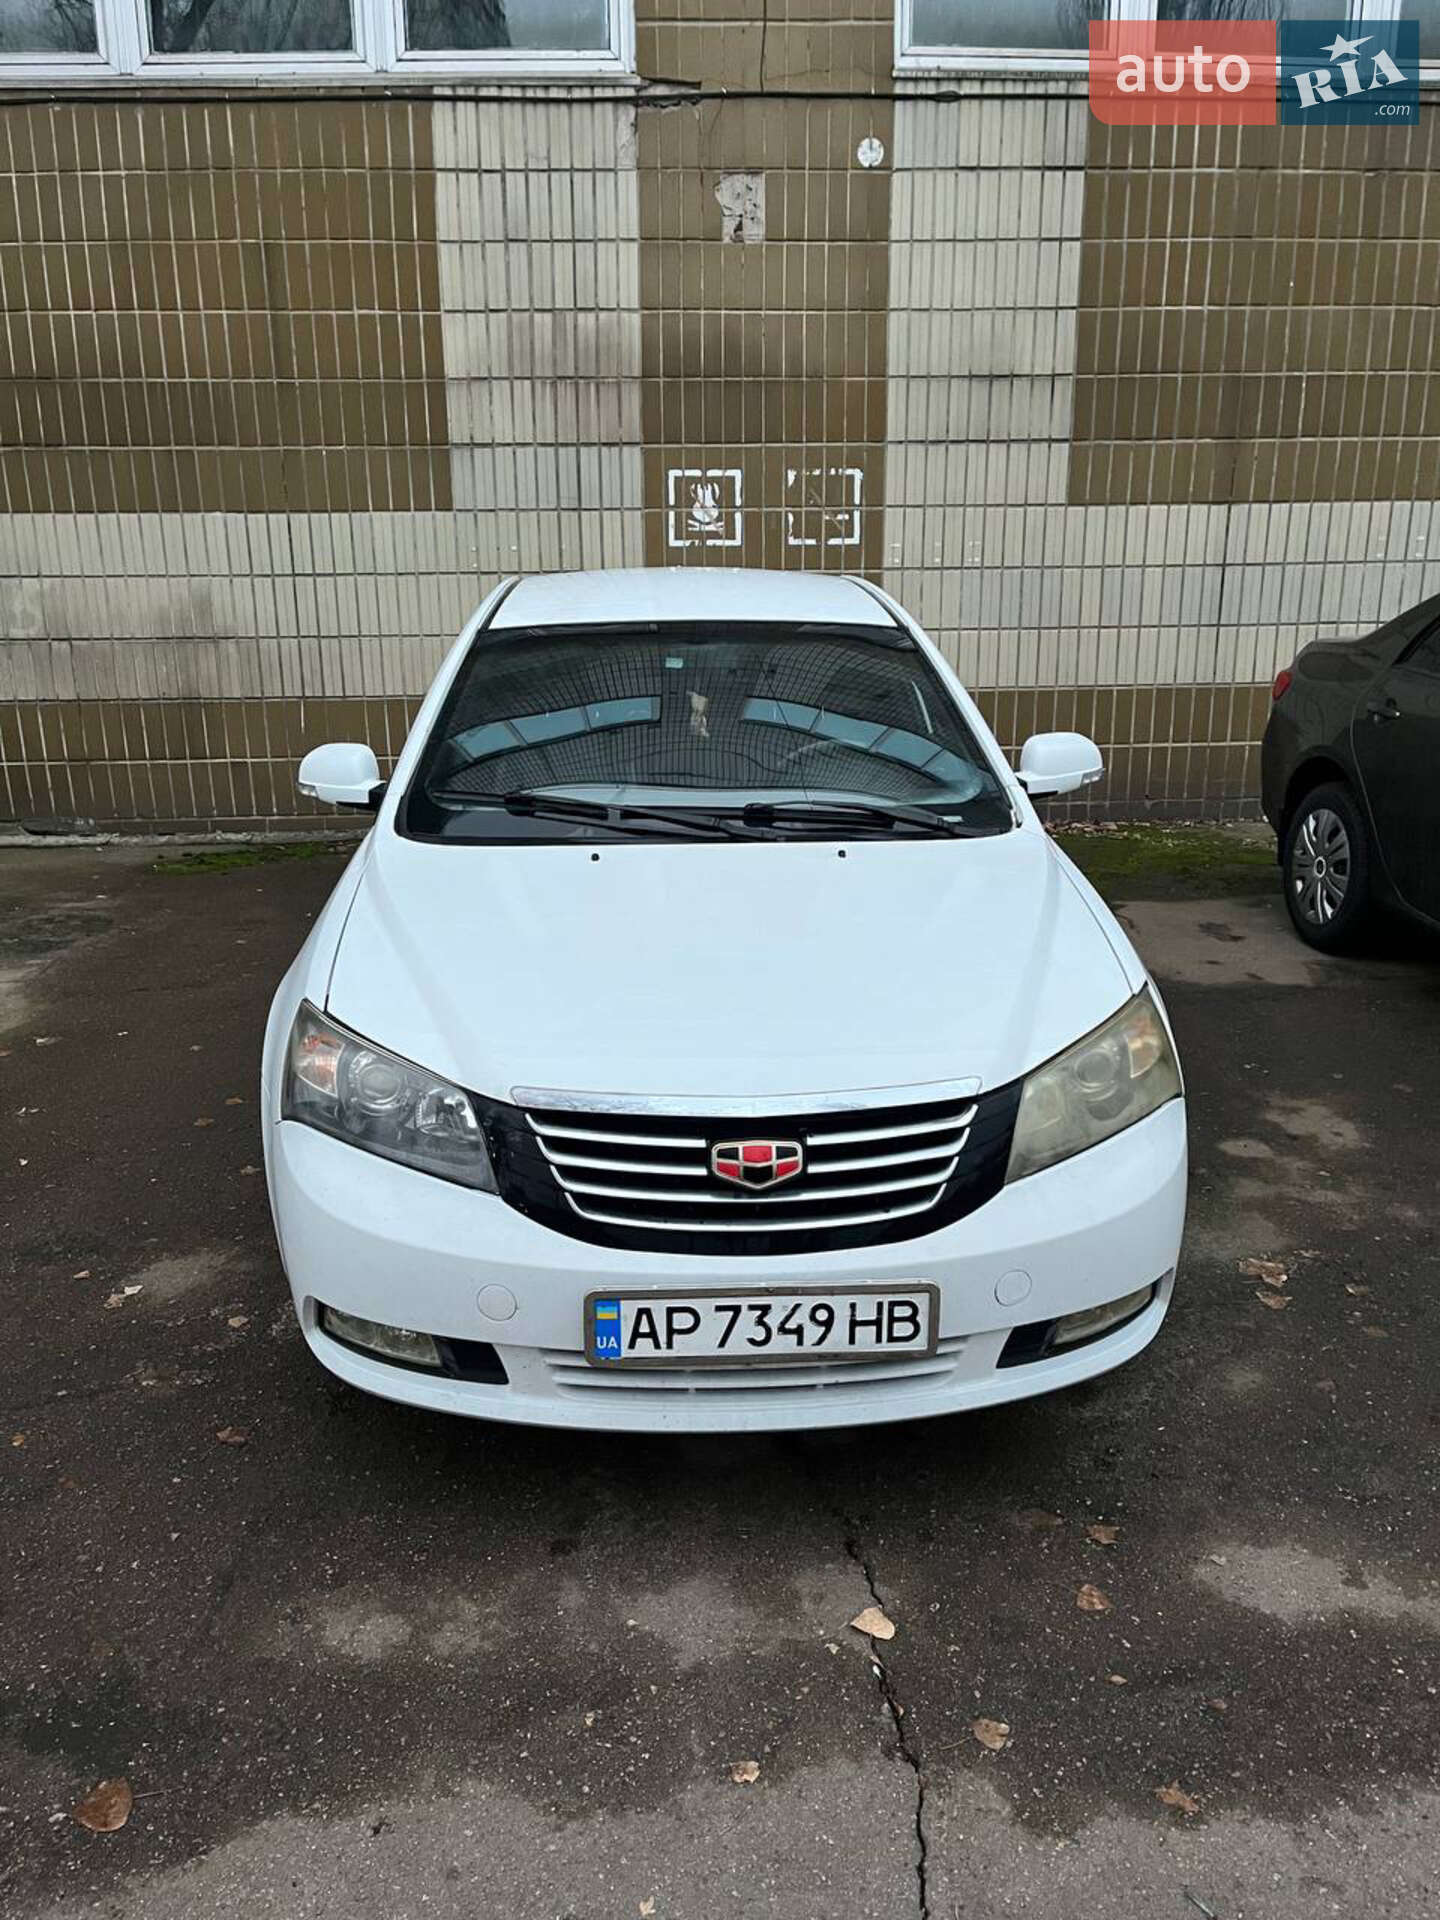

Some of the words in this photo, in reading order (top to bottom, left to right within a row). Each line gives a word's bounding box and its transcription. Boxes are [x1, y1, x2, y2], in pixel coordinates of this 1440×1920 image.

[627, 1306, 701, 1350] AP
[714, 1303, 835, 1348] 7349
[849, 1300, 922, 1345] HB
[596, 1336, 618, 1349] UA
